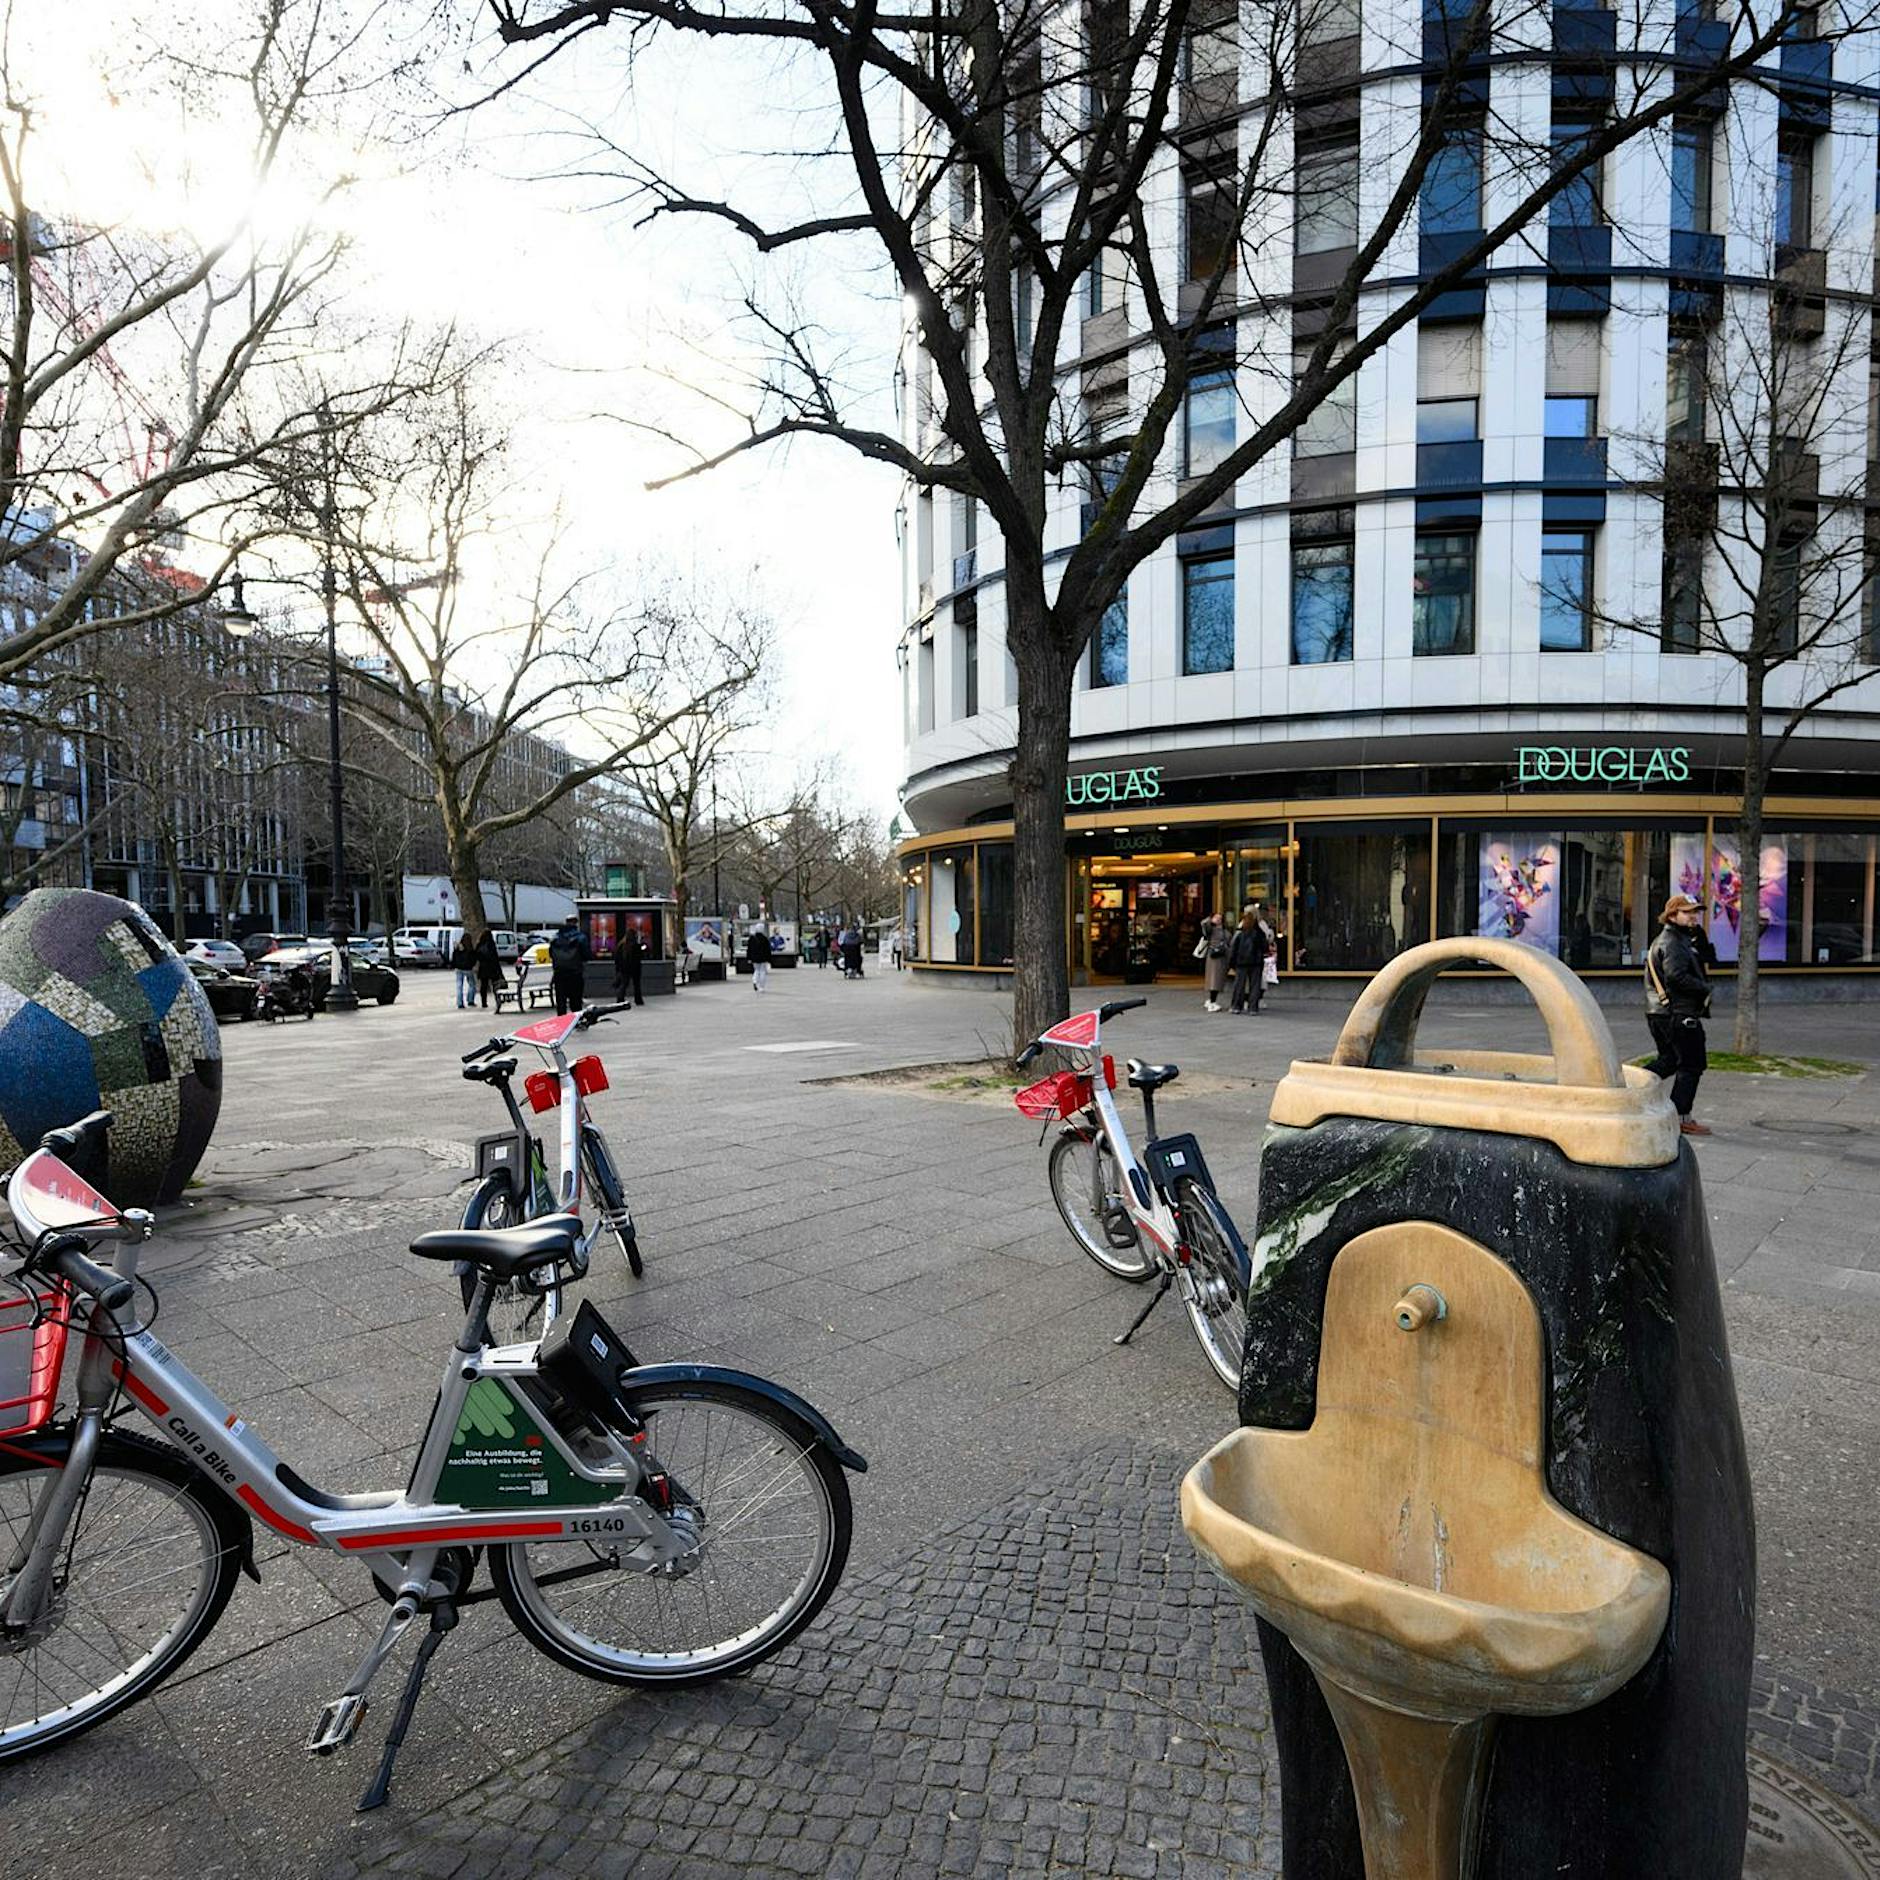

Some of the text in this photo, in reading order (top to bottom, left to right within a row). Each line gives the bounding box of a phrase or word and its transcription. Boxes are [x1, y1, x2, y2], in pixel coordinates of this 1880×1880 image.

[1519, 747, 1688, 781] DOUGLAS
[1066, 767, 1160, 804] UGLAS
[1114, 834, 1162, 850] DOUGLAS
[168, 1417, 236, 1484] Call a Bike
[465, 1449, 543, 1458] Eine Ausbildung, die
[448, 1458, 488, 1466] nachhaltig
[512, 1457, 543, 1466] bewegt.
[571, 1518, 624, 1533] 16140
